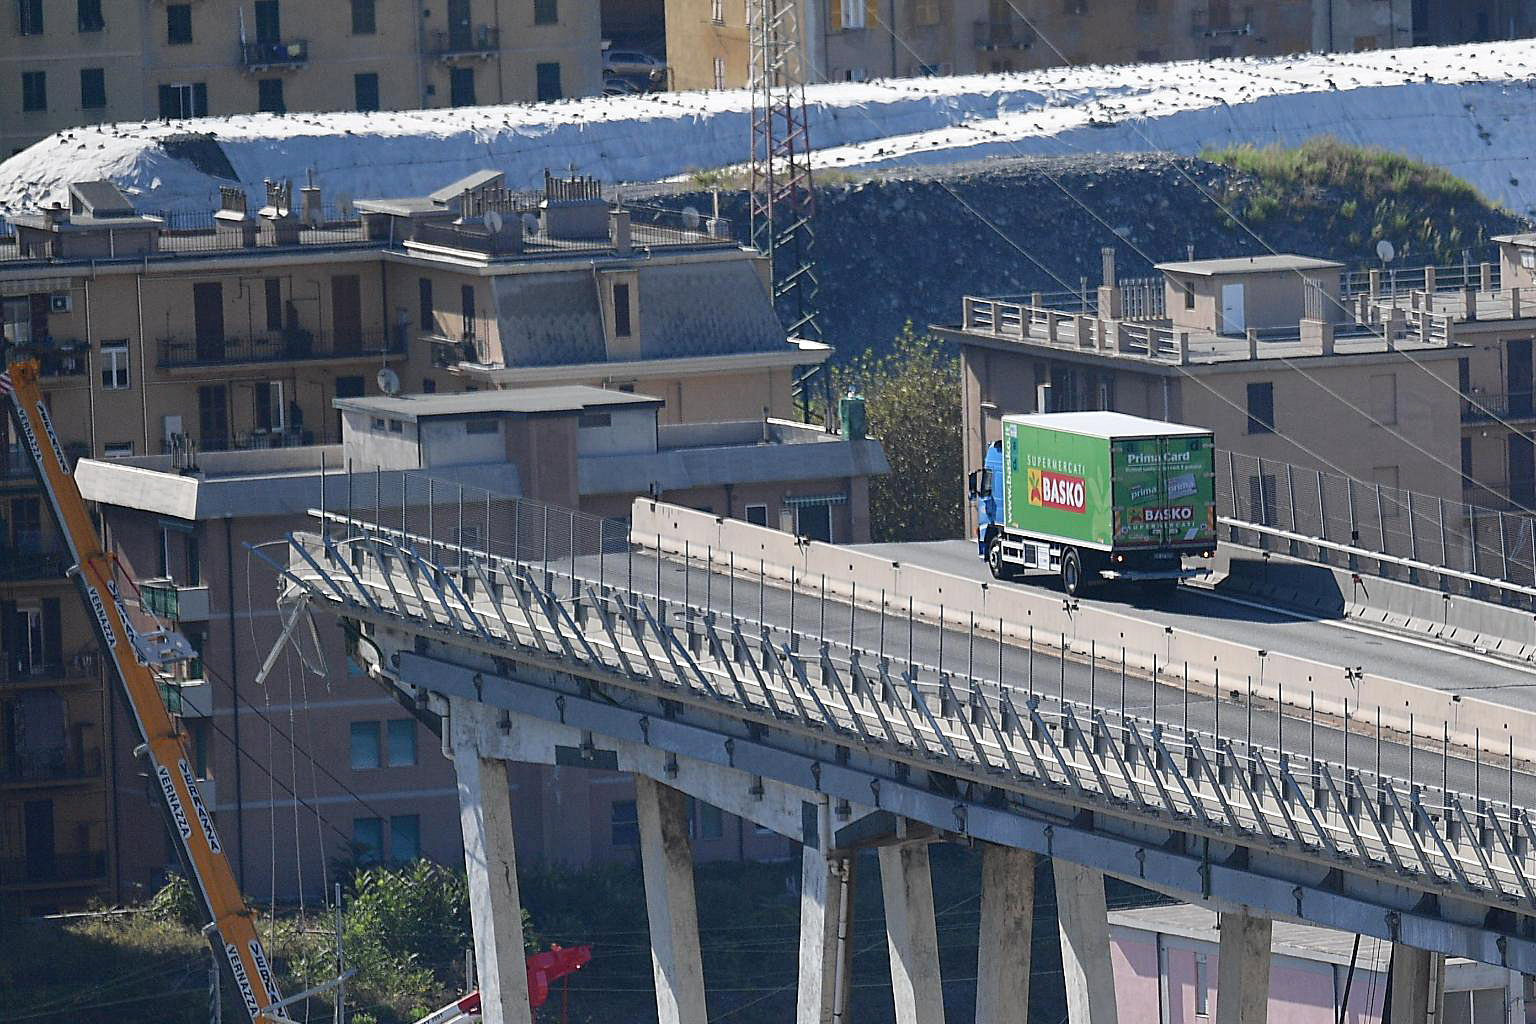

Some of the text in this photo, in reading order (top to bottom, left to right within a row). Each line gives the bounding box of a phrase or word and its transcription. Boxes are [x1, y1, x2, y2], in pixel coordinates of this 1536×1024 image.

[1027, 455, 1086, 475] SUPERMERCATI
[1128, 451, 1190, 464] Prima Card
[1042, 477, 1084, 508] BASKO
[1131, 486, 1157, 501] prima
[1145, 508, 1191, 521] BASKO
[90, 588, 116, 646] VERNAZZA
[159, 768, 190, 837] VERNAZZA
[180, 763, 219, 851] VERNAZZA
[228, 946, 259, 1016] VERNAZZA
